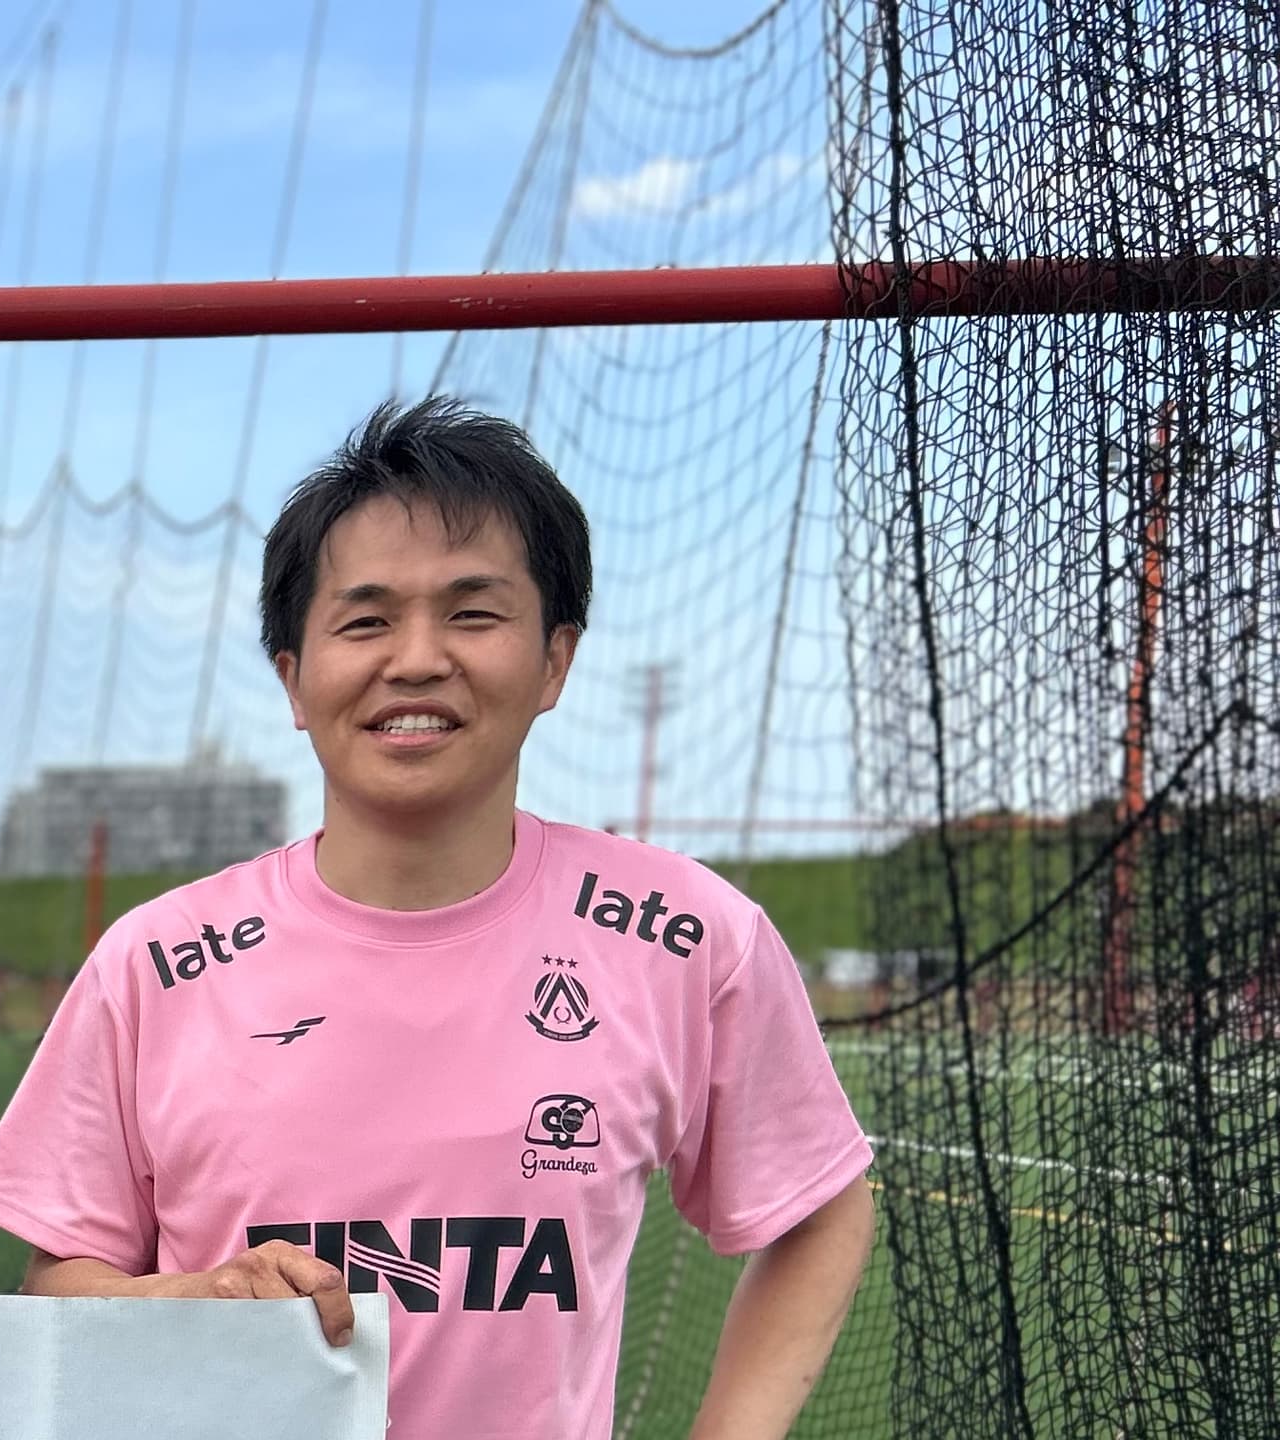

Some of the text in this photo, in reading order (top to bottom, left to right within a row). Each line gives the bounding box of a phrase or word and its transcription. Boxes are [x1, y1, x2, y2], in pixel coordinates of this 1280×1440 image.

[573, 871, 704, 959] late
[147, 916, 265, 990] late
[521, 1149, 598, 1179] Grandeza
